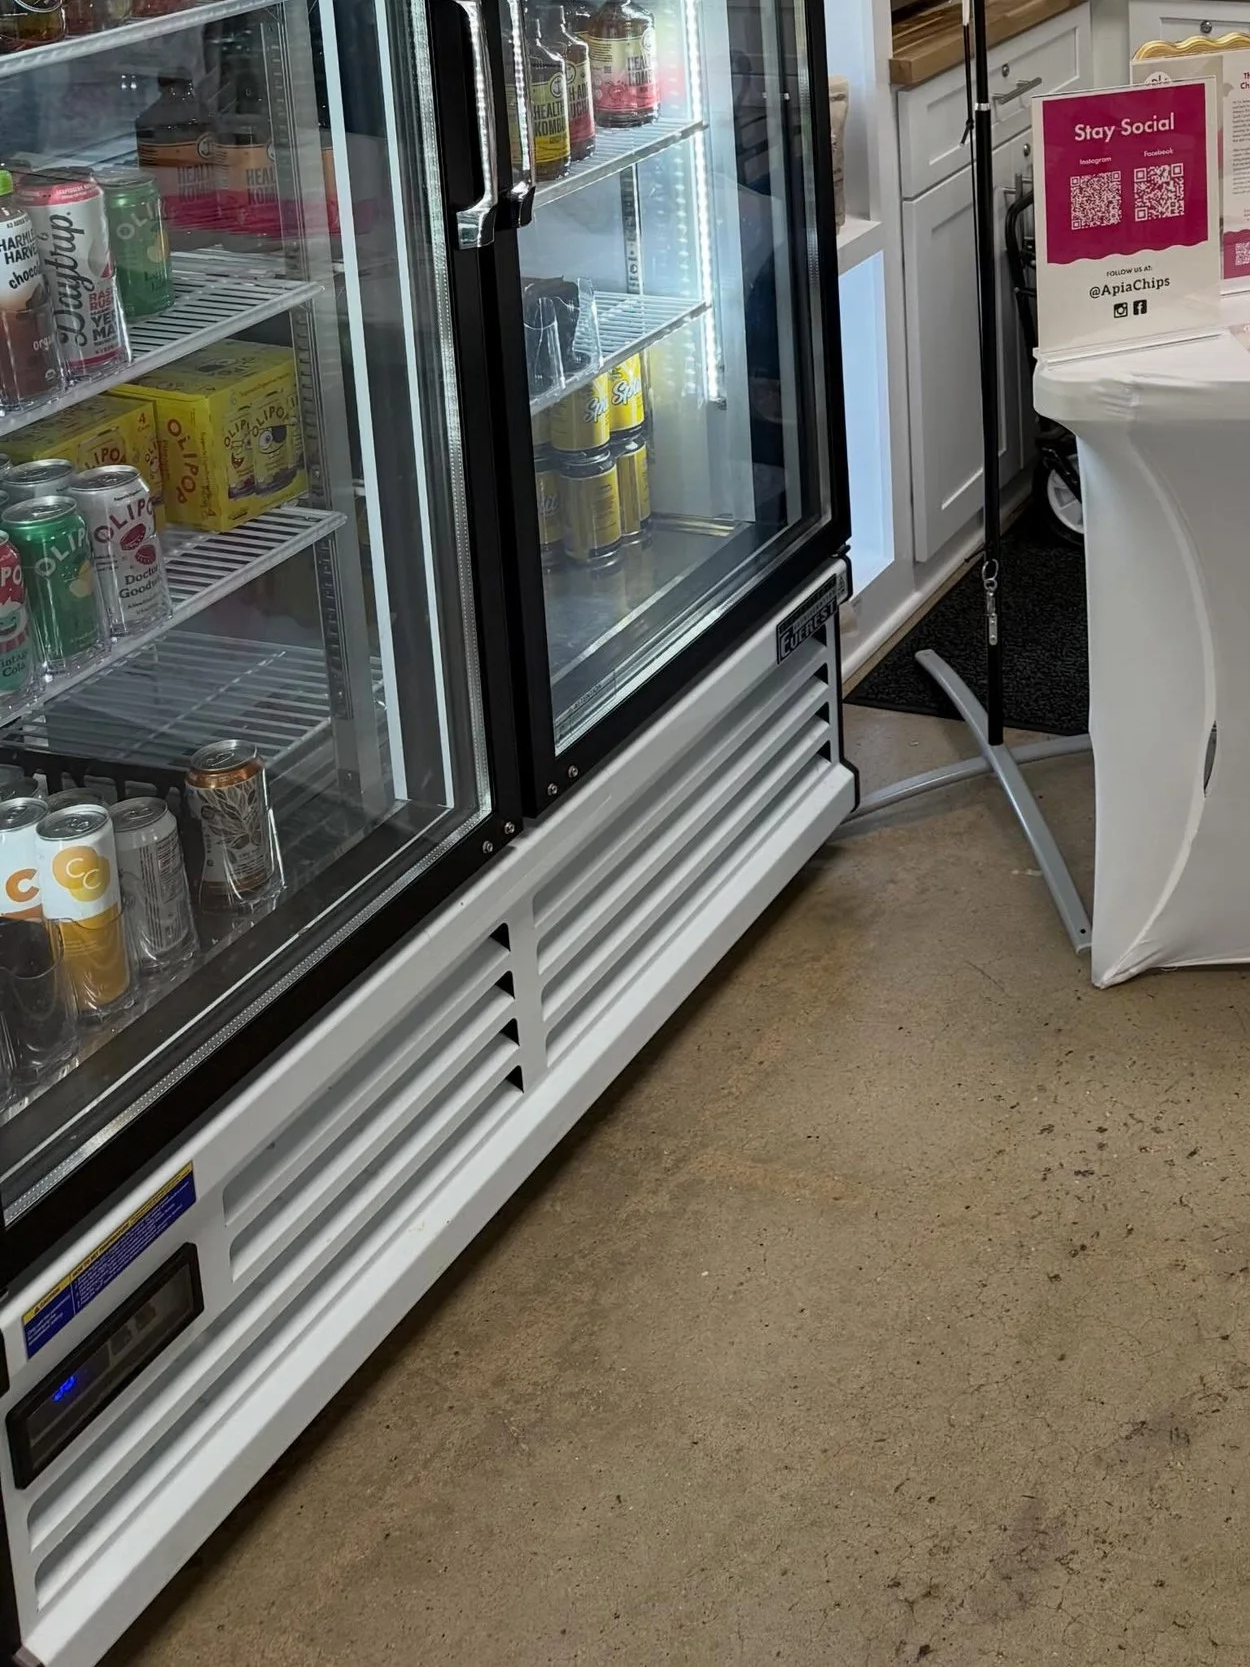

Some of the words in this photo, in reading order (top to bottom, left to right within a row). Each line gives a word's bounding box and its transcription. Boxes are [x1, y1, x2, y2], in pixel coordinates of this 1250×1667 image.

[1075, 124, 1116, 143] Stay
[1121, 112, 1174, 135] Social
[1144, 148, 1174, 157] Facebook
[1080, 157, 1112, 165] Instagram
[1106, 268, 1133, 277] FOLLOW
[1089, 277, 1170, 299] @ApiaChips
[167, 418, 199, 506] OLIPOP
